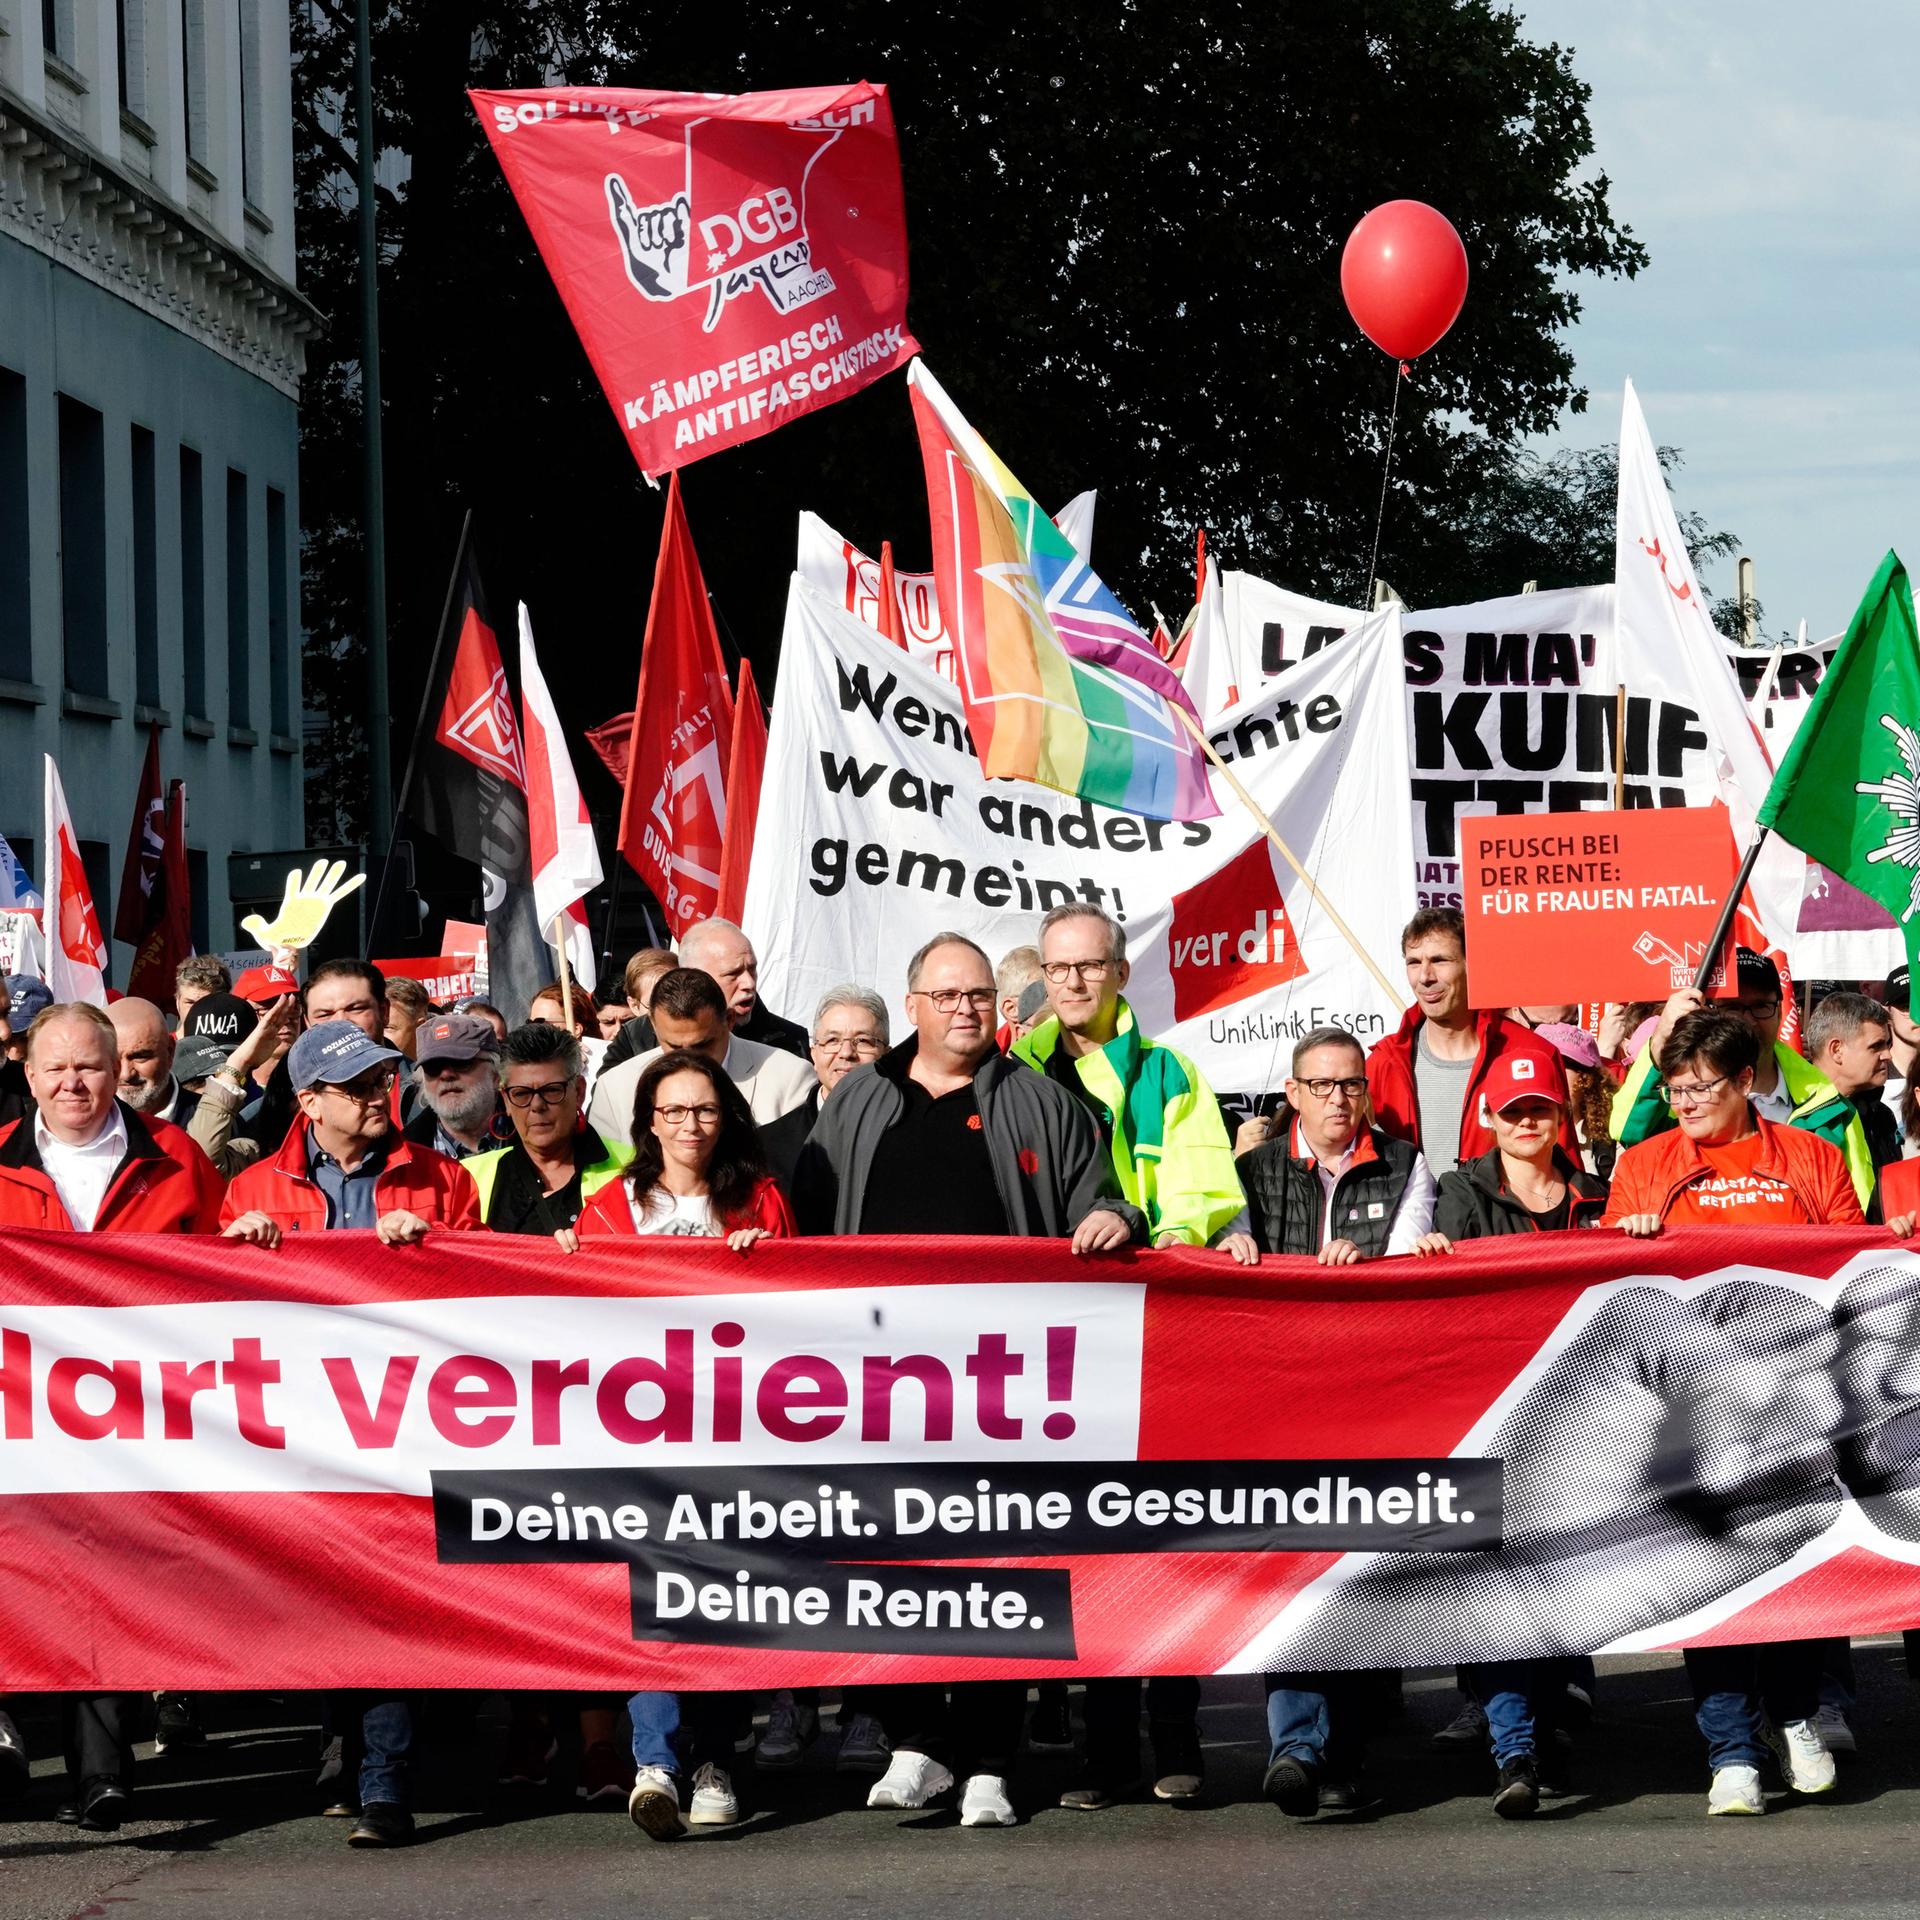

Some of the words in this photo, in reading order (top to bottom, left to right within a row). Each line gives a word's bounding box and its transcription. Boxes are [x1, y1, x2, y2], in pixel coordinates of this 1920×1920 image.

[698, 186, 797, 257] DGB
[788, 273, 833, 306] AACHEN
[624, 314, 843, 429] KÄMPFERISCH
[675, 323, 906, 450] ANTIFASCHISTISCH
[820, 750, 954, 818] war
[1479, 837, 1574, 860] PFUSCH
[1582, 834, 1619, 856] BEI
[1481, 866, 1528, 888] DER
[1536, 862, 1621, 886] RENTE:
[1481, 887, 1530, 916] FÜR
[1536, 887, 1634, 912] FRAUEN
[1641, 885, 1717, 908] FATAL.
[1173, 909, 1286, 969] ver.di
[195, 1012, 239, 1036] N.W.A
[1209, 1012, 1307, 1045] Uniklinik
[1310, 1007, 1386, 1035] Essen
[321, 1322, 1078, 1450] verdient!
[471, 1491, 649, 1543] Deine
[665, 1486, 878, 1540] Arbeit.
[894, 1480, 1072, 1535] Deine
[1086, 1474, 1476, 1530] Gesundheit.
[655, 1570, 833, 1625] Deine
[846, 1579, 1045, 1631] Rente.
